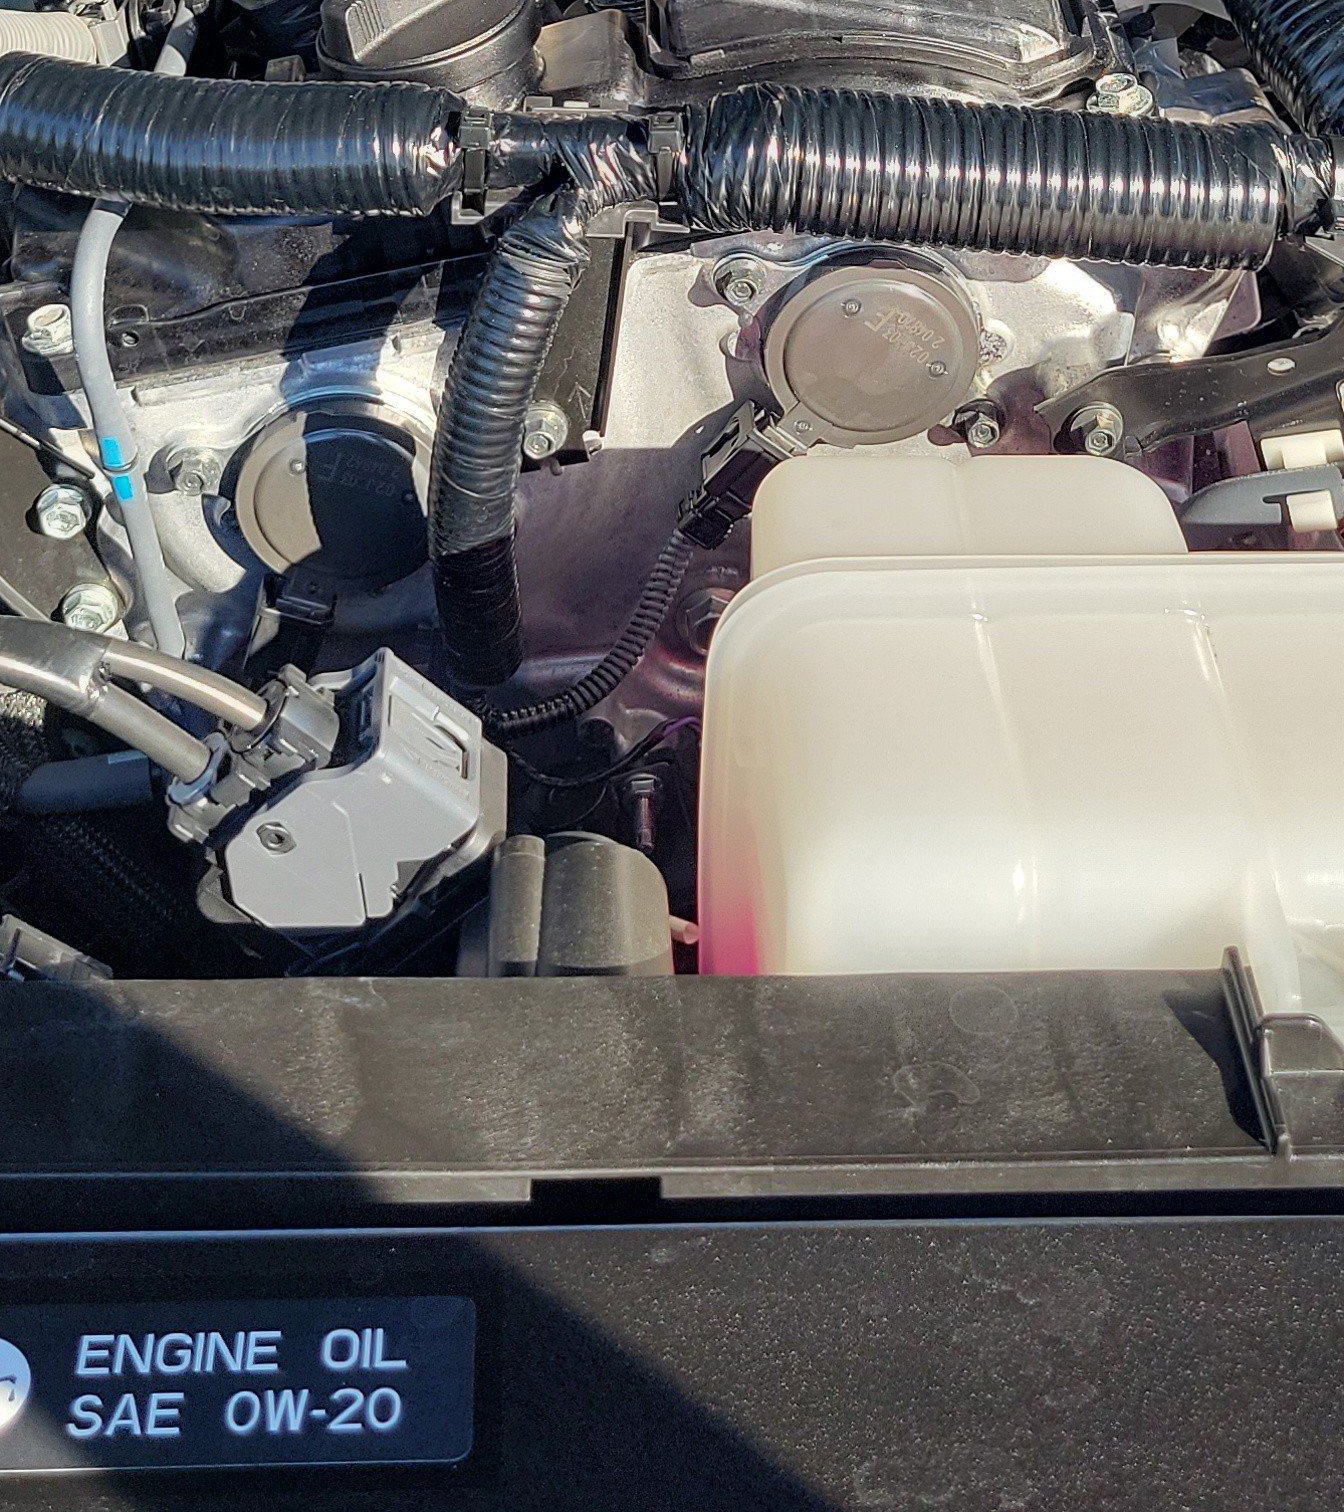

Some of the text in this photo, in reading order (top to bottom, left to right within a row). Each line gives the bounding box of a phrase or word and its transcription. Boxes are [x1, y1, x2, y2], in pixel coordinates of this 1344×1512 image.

[74, 1327, 409, 1376] ENGINE OIL
[65, 1387, 403, 1439] SAE 0W-20
